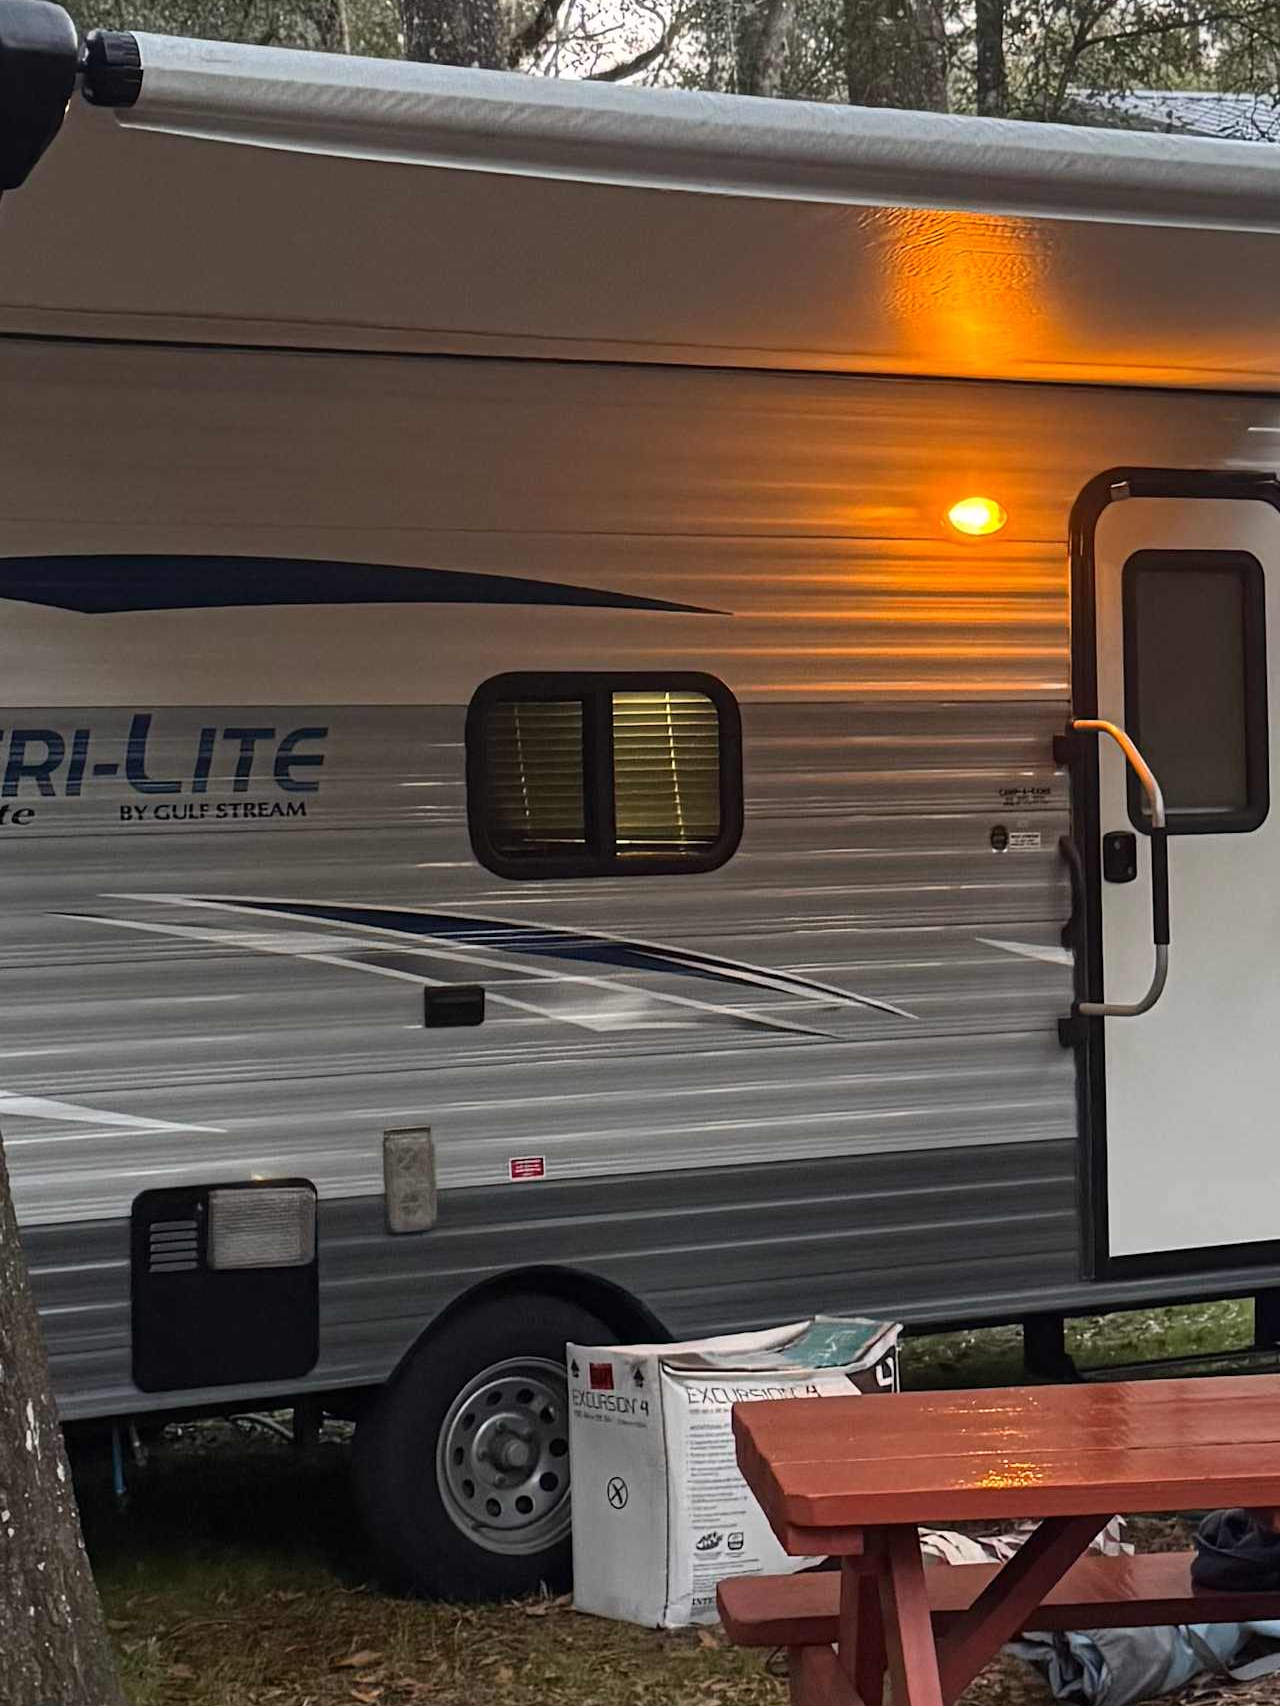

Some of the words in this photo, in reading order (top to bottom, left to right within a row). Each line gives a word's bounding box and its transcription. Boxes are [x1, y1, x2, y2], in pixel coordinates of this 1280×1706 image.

[120, 804, 148, 821] BY
[154, 803, 209, 820] GULF
[216, 801, 307, 819] STREAM
[640, 1399, 649, 1417] 4
